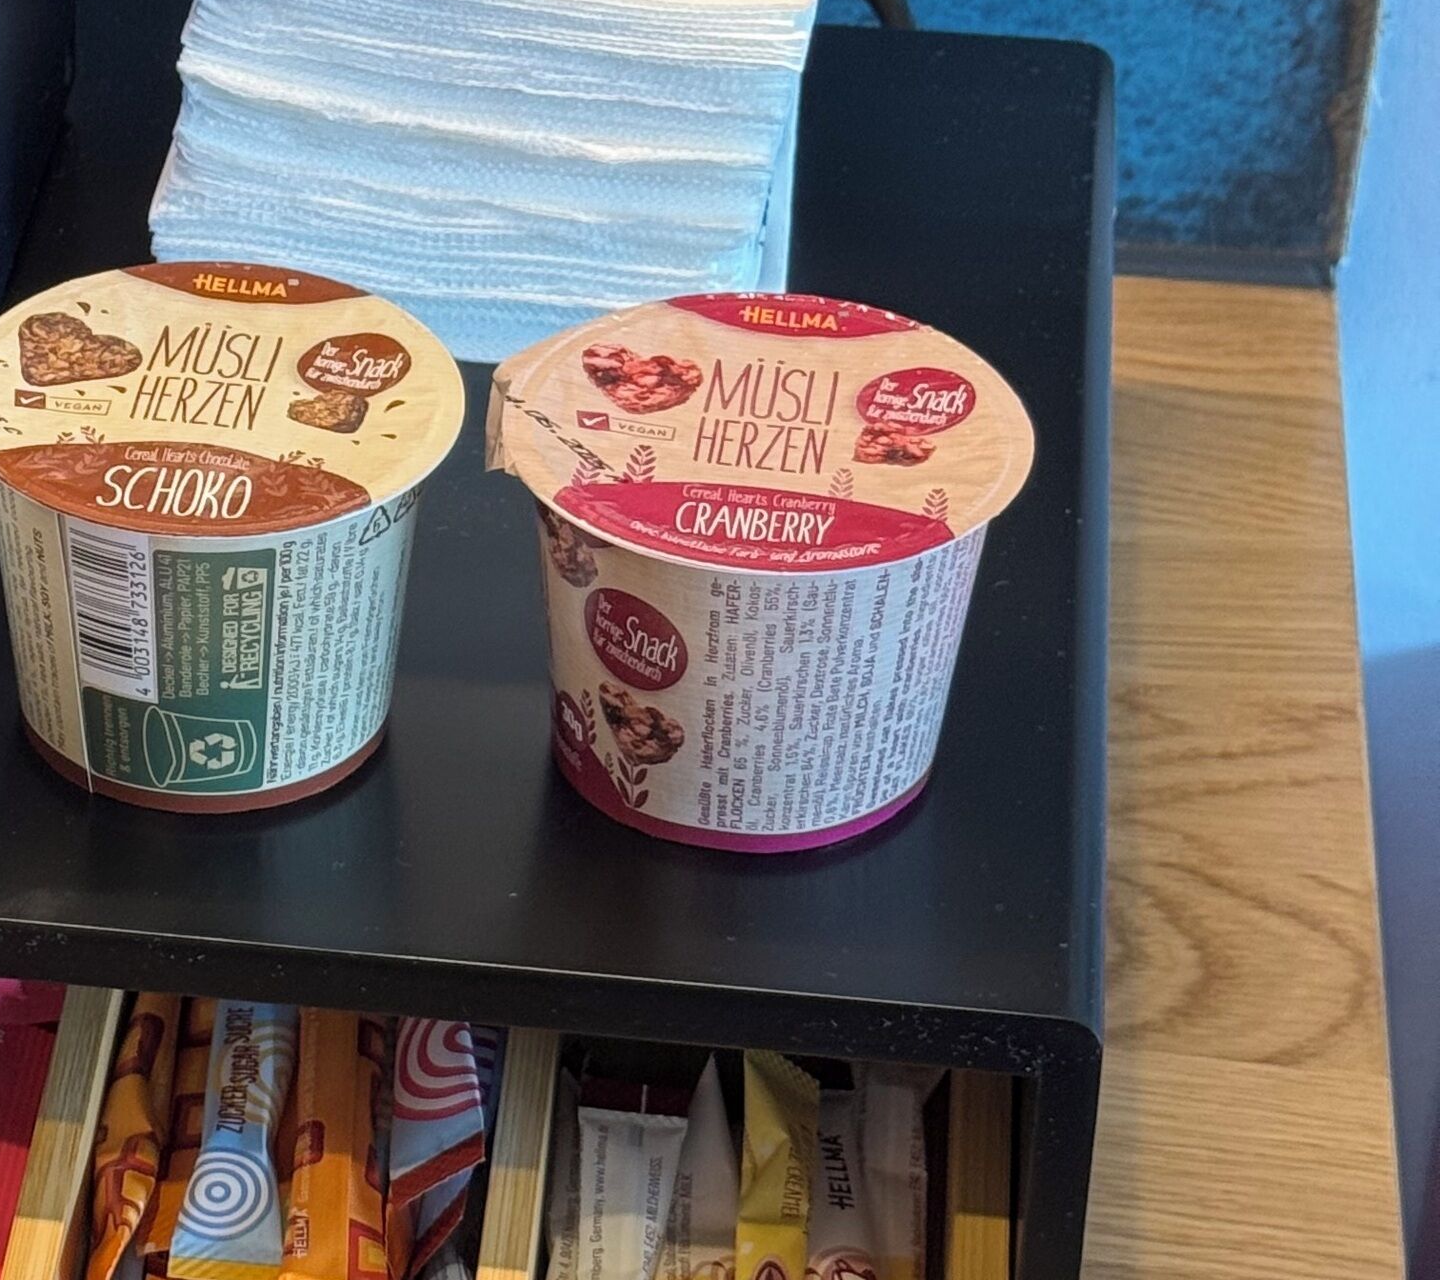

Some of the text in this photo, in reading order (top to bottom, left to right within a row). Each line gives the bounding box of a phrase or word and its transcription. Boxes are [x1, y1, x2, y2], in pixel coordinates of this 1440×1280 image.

[192, 273, 288, 298] HELLMA
[739, 305, 838, 332] HELLMA
[146, 322, 284, 383] MÜSLI
[345, 348, 403, 379] Snack
[55, 400, 103, 412] VEGAN
[129, 374, 266, 431] HERZEN
[703, 358, 840, 426] MÜSLI
[907, 383, 967, 414] Snack
[124, 446, 158, 462] Cereal
[161, 447, 197, 463] Hearts
[618, 422, 667, 437] VEGAN
[692, 416, 829, 475] HERZEN
[95, 465, 252, 519] SCHOKO
[682, 484, 837, 515] Cereal Hearts Cranberry
[675, 500, 836, 546] CRANBERRY
[196, 585, 211, 645] Kunststoff,
[724, 579, 740, 625] HAFER-
[780, 581, 801, 654] Sauerkirsch-
[801, 580, 820, 612] (Sau-
[868, 567, 890, 631] SCHALEN-
[129, 550, 151, 697] 4 003148 733126
[221, 594, 239, 673] DESIGNED FOR
[240, 590, 262, 673] RECYCLING
[623, 616, 678, 671] Snack
[179, 644, 194, 699] Banderole
[197, 659, 210, 696] Becher
[703, 675, 718, 687] in
[722, 634, 738, 681] Zutaten:
[731, 778, 746, 830] FLOCKEN
[744, 580, 760, 620] Kokos-
[700, 699, 717, 770] Haferflocken
[715, 767, 729, 785] mit
[229, 1044, 260, 1084] SUGAR
[216, 1084, 247, 1134] ZUCKER
[823, 1134, 855, 1210] HELLMA
